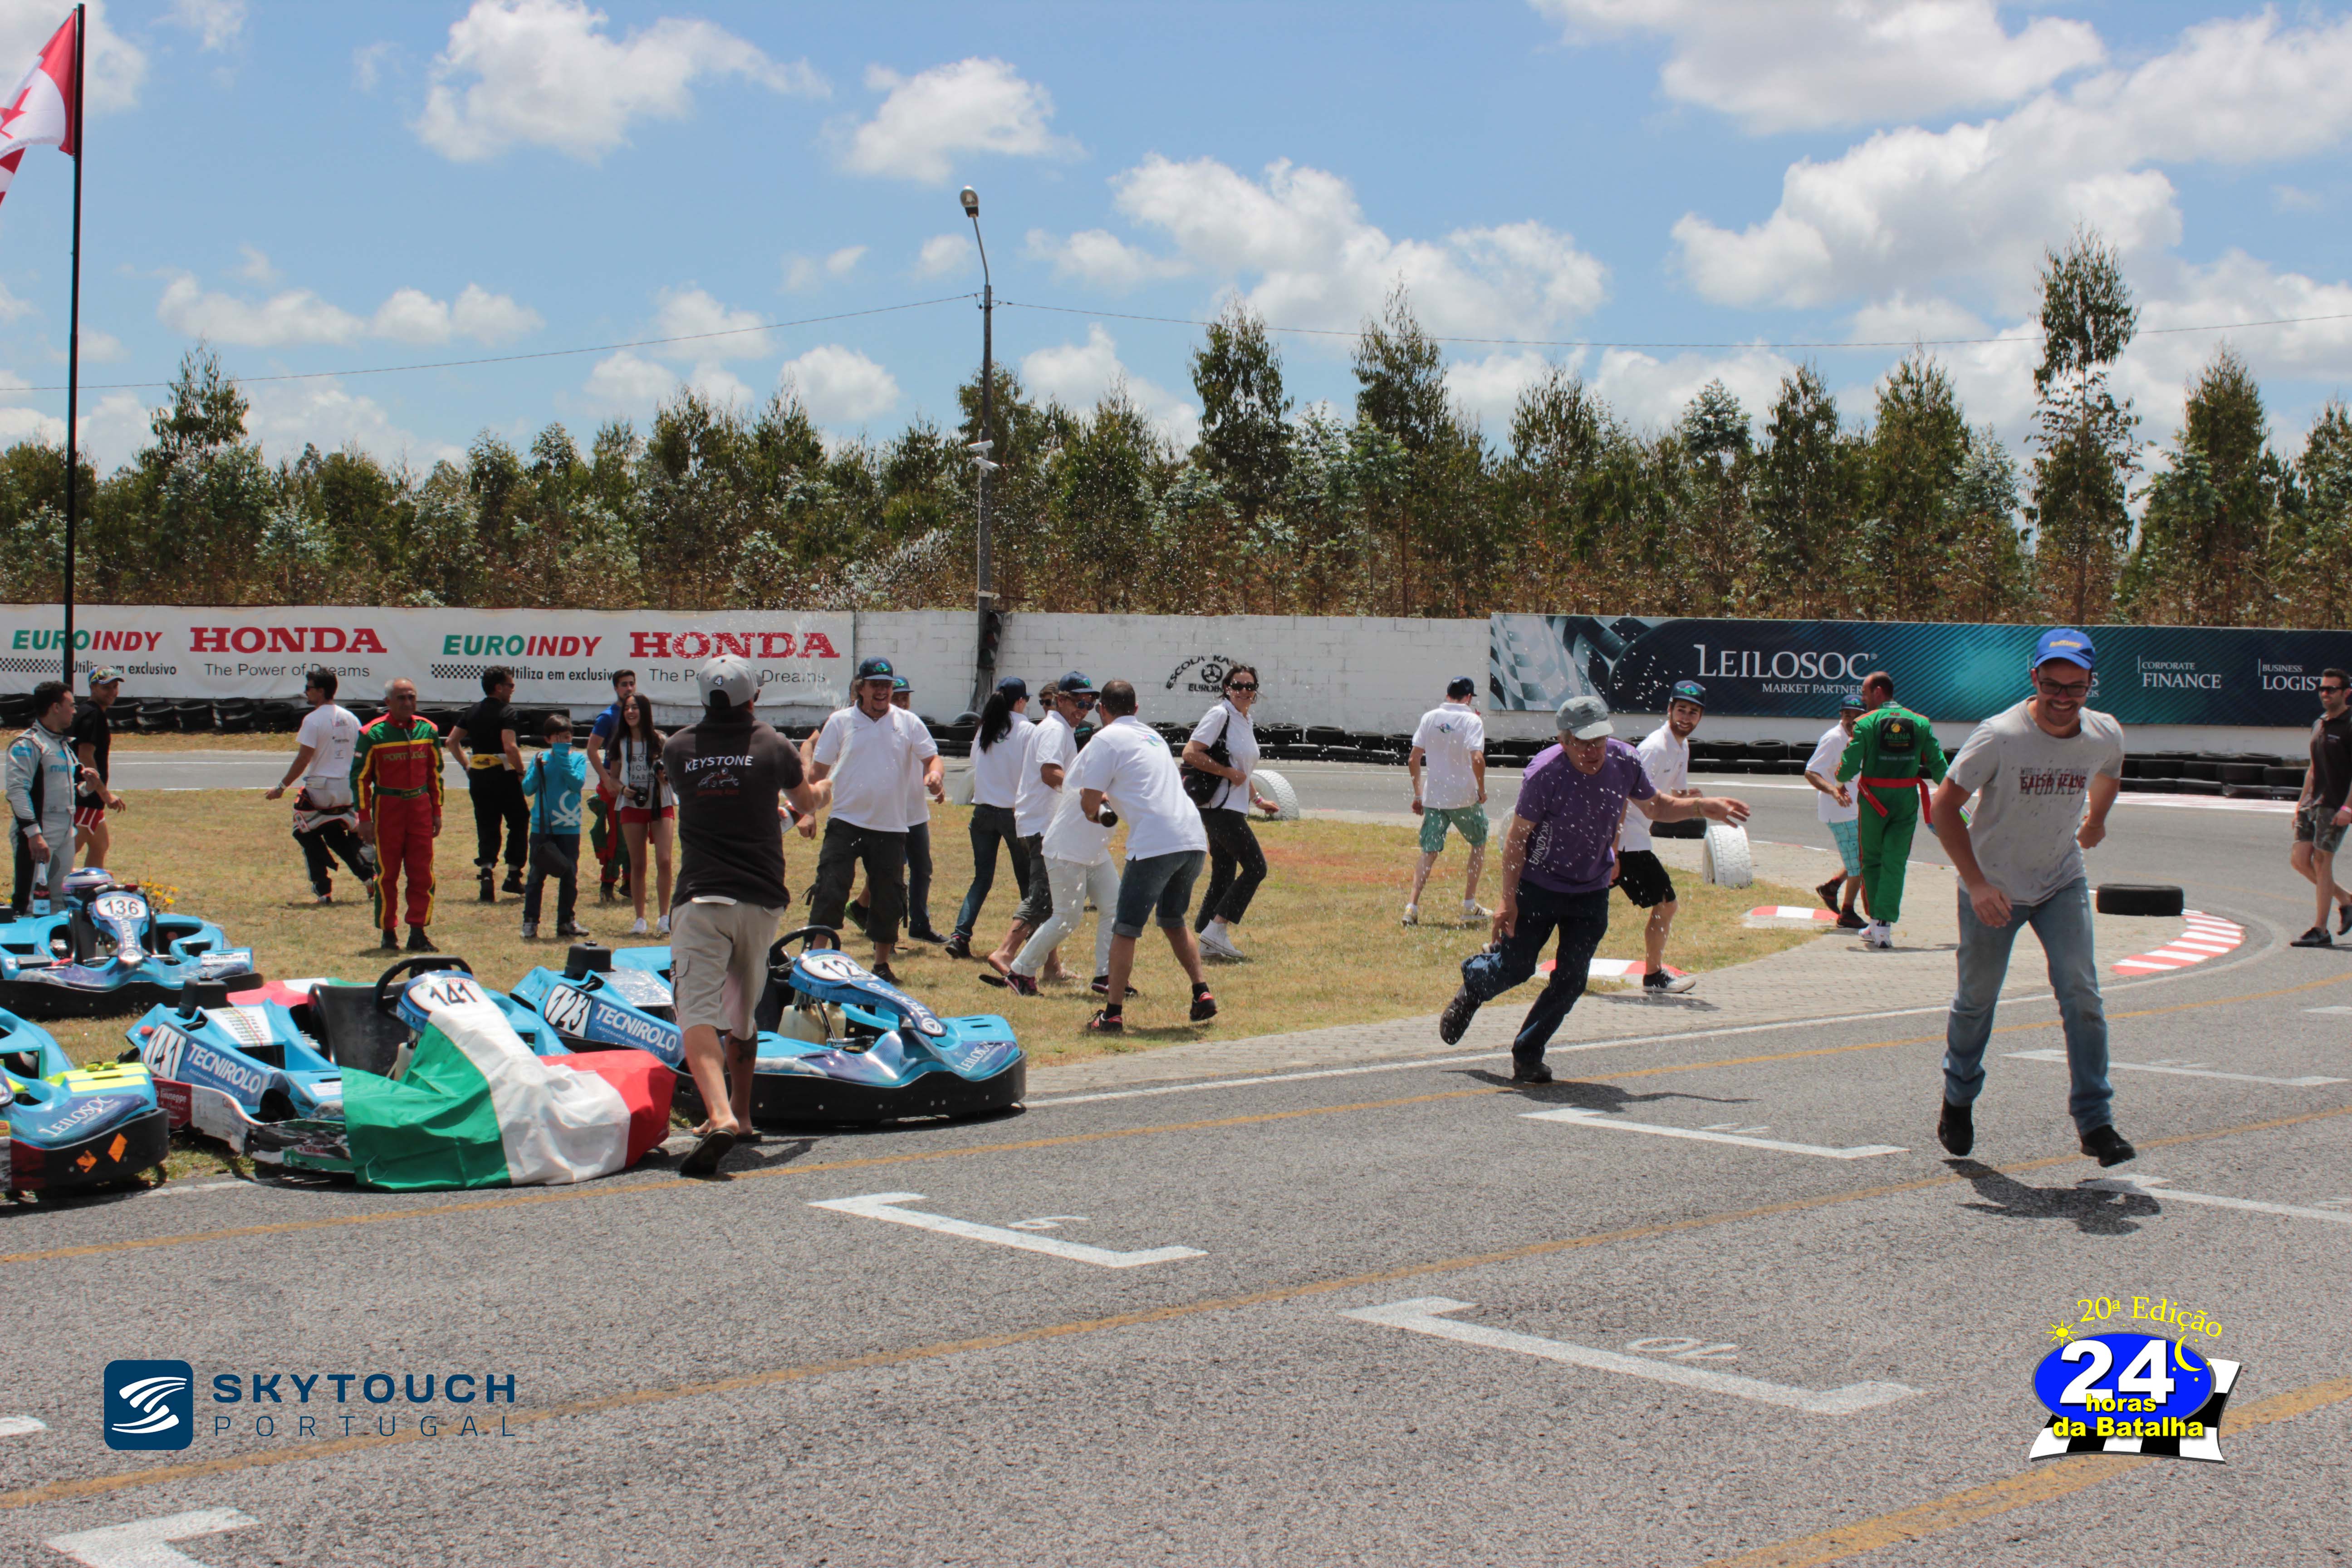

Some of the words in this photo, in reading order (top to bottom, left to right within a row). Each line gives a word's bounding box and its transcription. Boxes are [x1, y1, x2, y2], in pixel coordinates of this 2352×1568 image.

[12, 629, 163, 652] EUROINDY
[190, 627, 387, 653] HONDA
[443, 634, 603, 657] EUROINDY
[630, 632, 840, 659] HONDA
[128, 661, 177, 675] exclusivo
[205, 664, 232, 676] The
[238, 664, 286, 676] Power
[292, 663, 307, 676] of
[311, 664, 370, 676] Deams
[548, 670, 564, 680] em
[569, 668, 613, 681] exclusiv
[649, 669, 679, 681] The
[1166, 656, 1205, 689] ESCOLA
[2141, 662, 2195, 670] CORPORATE
[2262, 664, 2303, 672] BUSINESS
[714, 676, 723, 686] 4
[1188, 684, 1224, 692] EUROIN
[1762, 684, 1810, 693] MARKET
[2142, 673, 2222, 689] FINANCE
[685, 755, 754, 773] KEYSTONE
[105, 900, 140, 915] 136
[430, 983, 479, 1006] 141
[547, 989, 590, 1031] 123
[595, 1003, 677, 1052] TECNIROLO
[149, 1026, 181, 1078] 141
[187, 1043, 261, 1094] TECNIROLO
[38, 1096, 114, 1137] LEILOSOC
